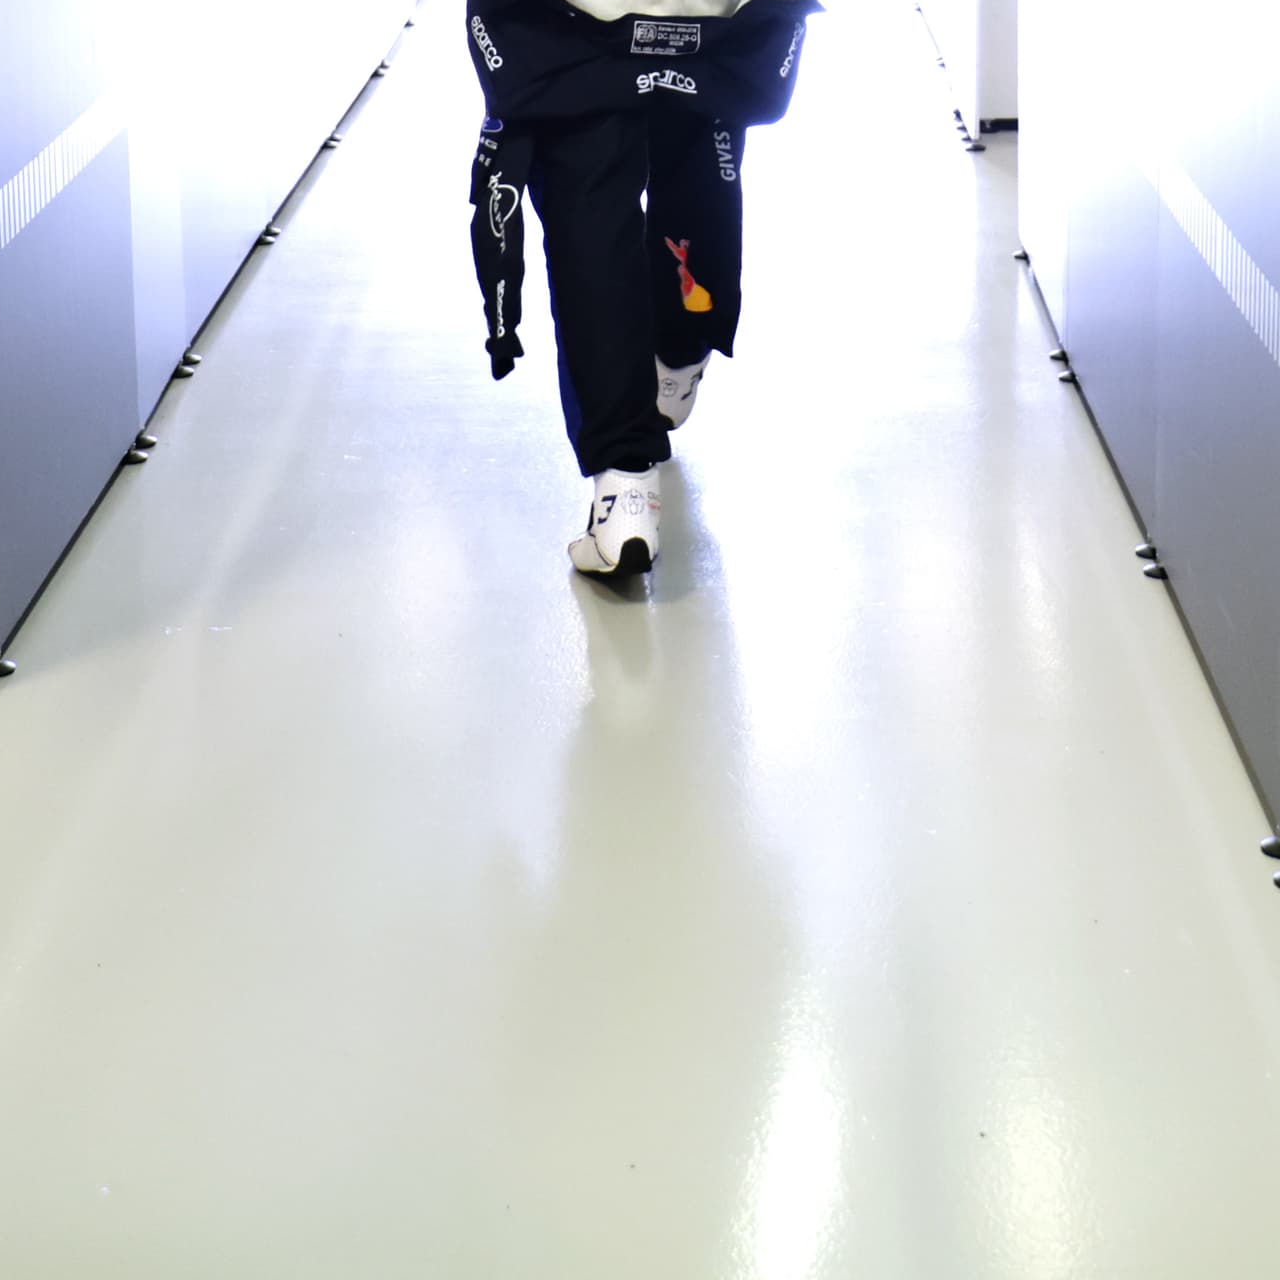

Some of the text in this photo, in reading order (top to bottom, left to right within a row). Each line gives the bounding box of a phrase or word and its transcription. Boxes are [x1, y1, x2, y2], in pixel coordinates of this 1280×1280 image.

[471, 15, 504, 71] sparco
[714, 131, 737, 182] GIVES
[597, 494, 618, 525] 3
